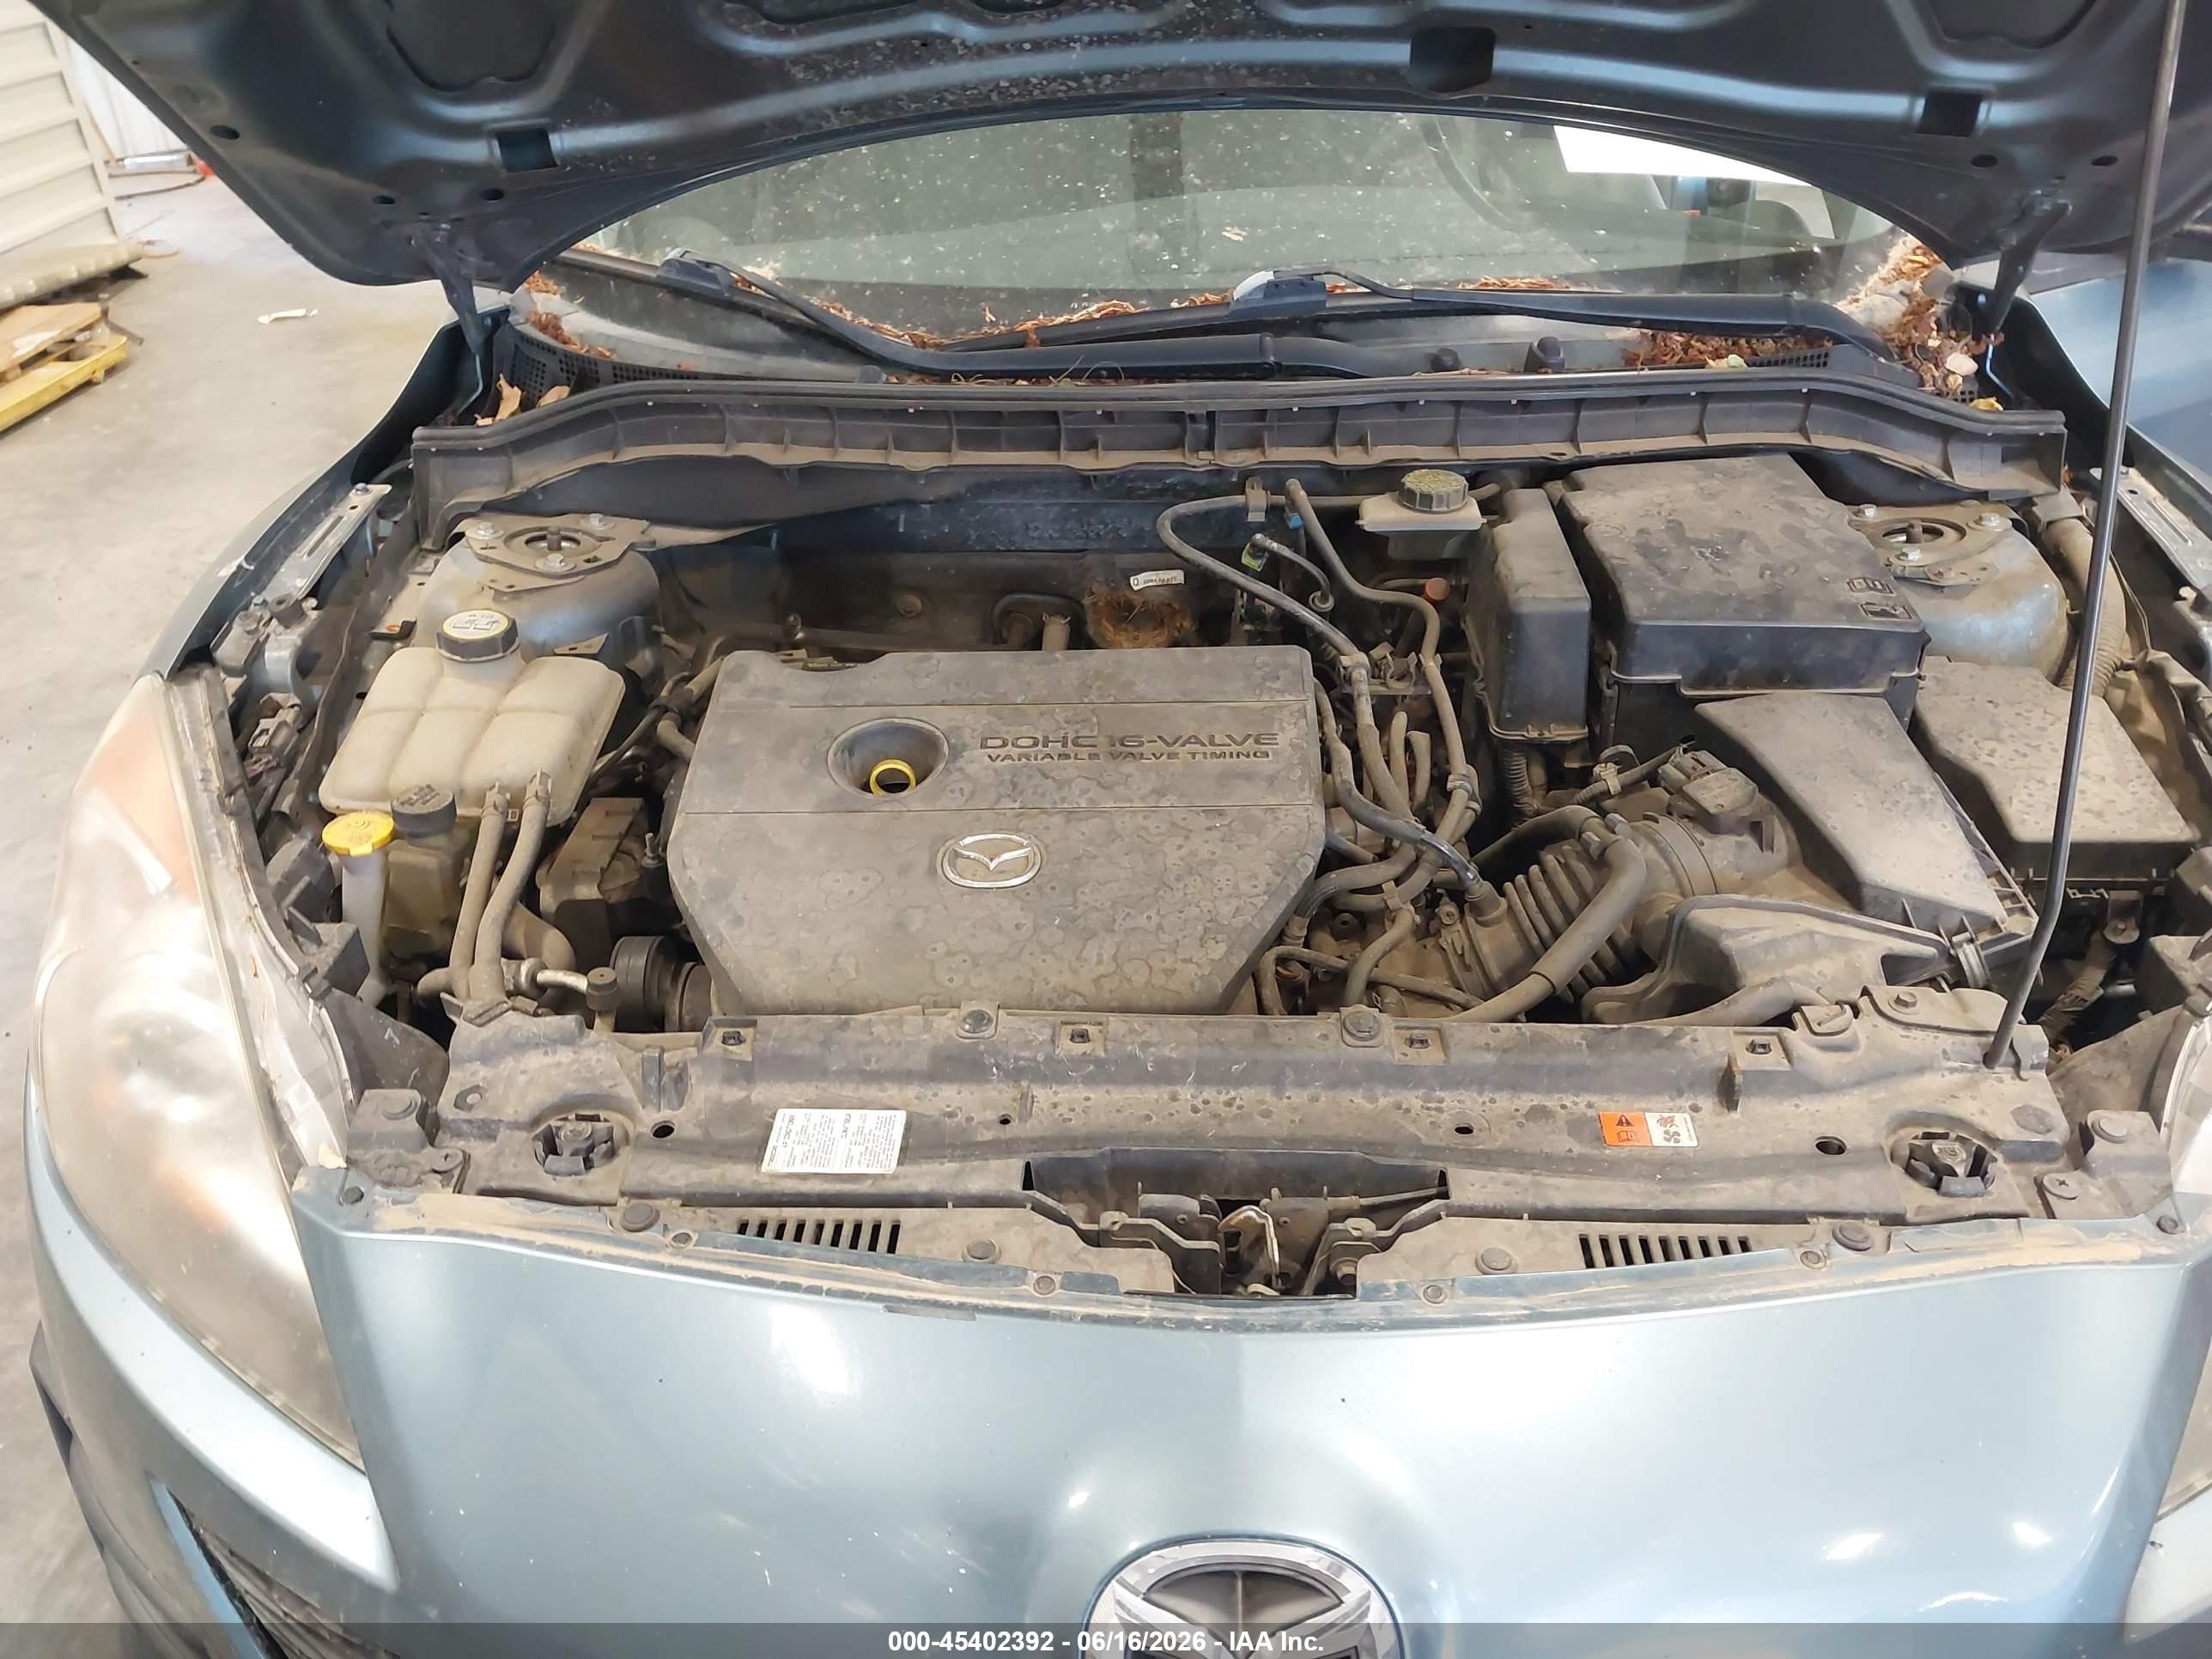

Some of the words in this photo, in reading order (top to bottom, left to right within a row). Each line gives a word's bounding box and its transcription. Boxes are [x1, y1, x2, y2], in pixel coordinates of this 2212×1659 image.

[980, 735, 1097, 750] DOHC
[1109, 732, 1279, 748] 16-VALVE
[988, 752, 1101, 763] VARIABLE
[1109, 751, 1181, 762] VALVE
[1188, 750, 1270, 761] TIMING
